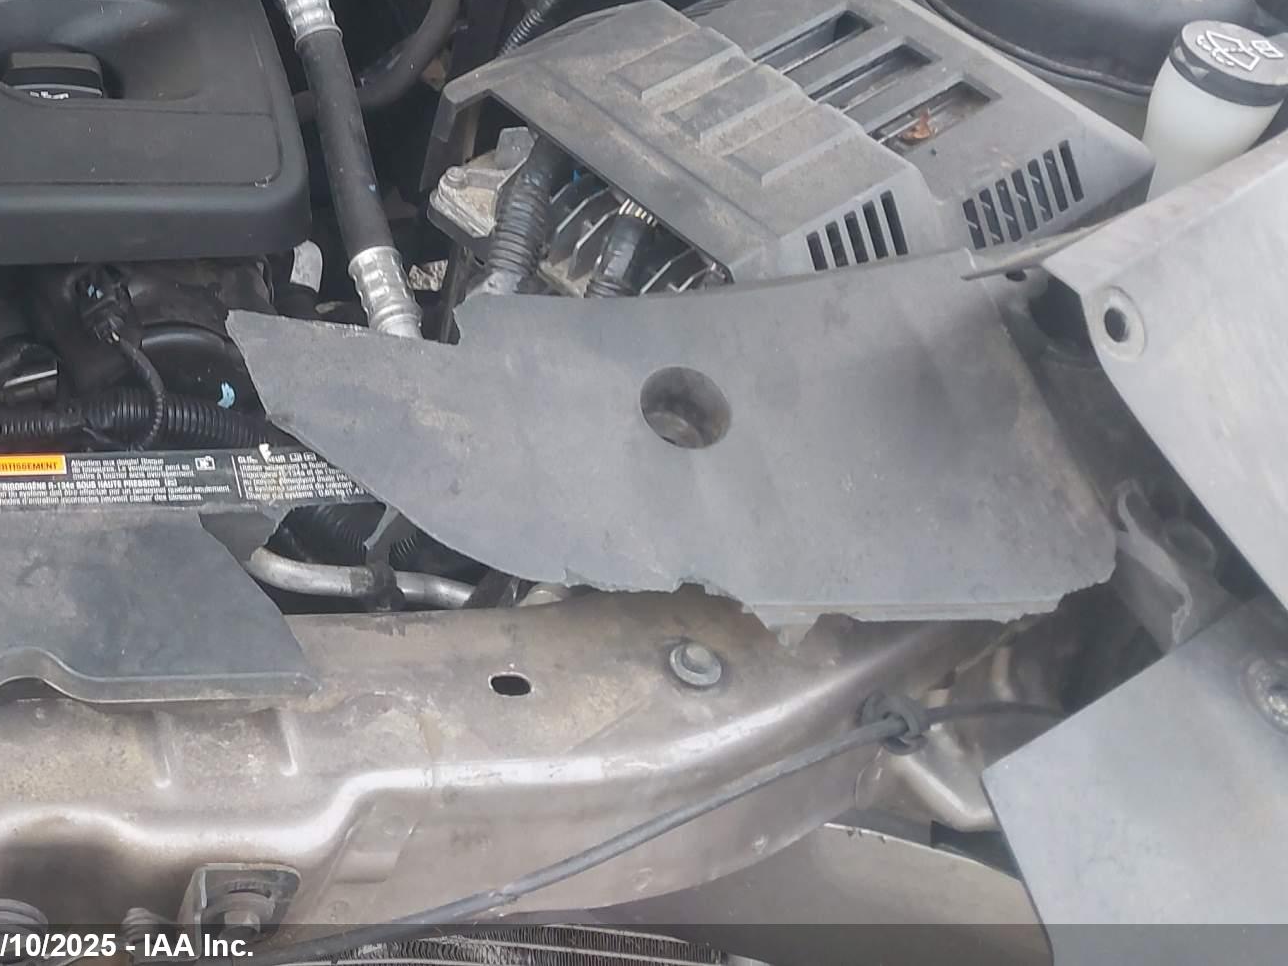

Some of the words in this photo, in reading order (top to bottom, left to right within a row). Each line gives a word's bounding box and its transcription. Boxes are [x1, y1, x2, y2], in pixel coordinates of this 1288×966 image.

[76, 480, 97, 490] SOUS
[98, 480, 122, 489] HAUTE
[123, 479, 161, 488] PRESSION
